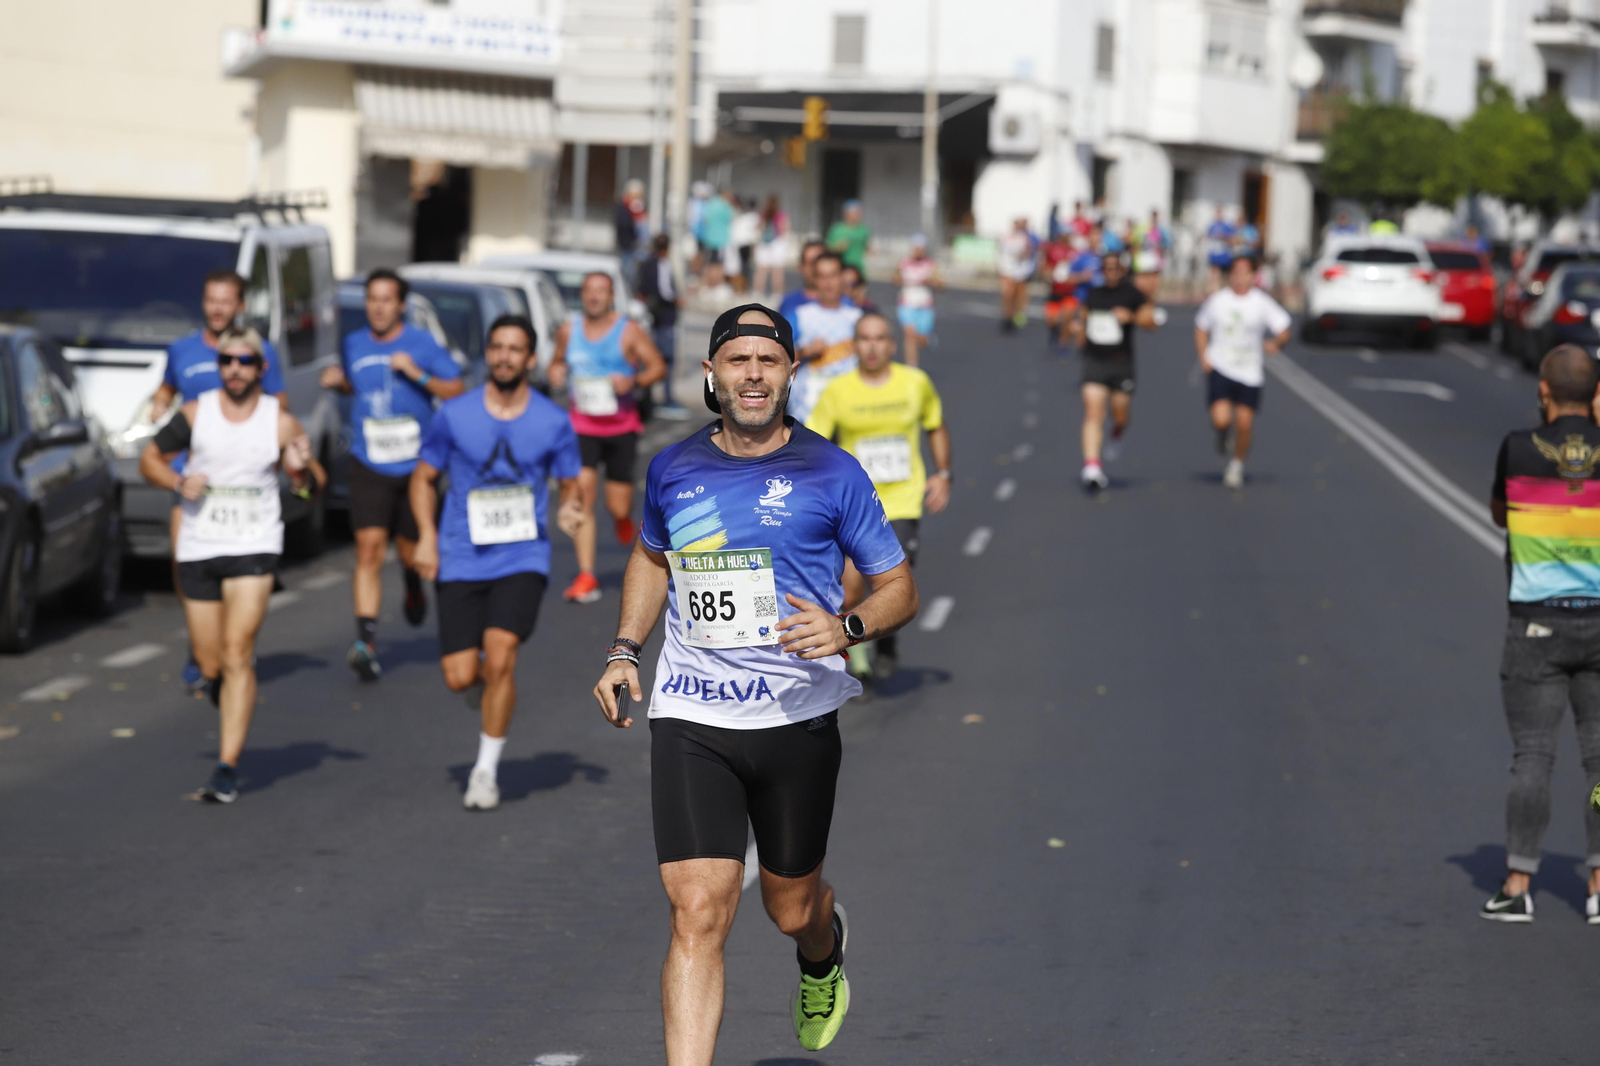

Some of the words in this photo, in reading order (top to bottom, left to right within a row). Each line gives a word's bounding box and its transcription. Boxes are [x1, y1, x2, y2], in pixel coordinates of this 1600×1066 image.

[759, 515, 782, 527] Run
[718, 555, 725, 569] A
[727, 554, 764, 569] HUELVA
[689, 591, 736, 622] 685
[661, 673, 776, 703] HUELVA
[807, 720, 828, 731] adidas
